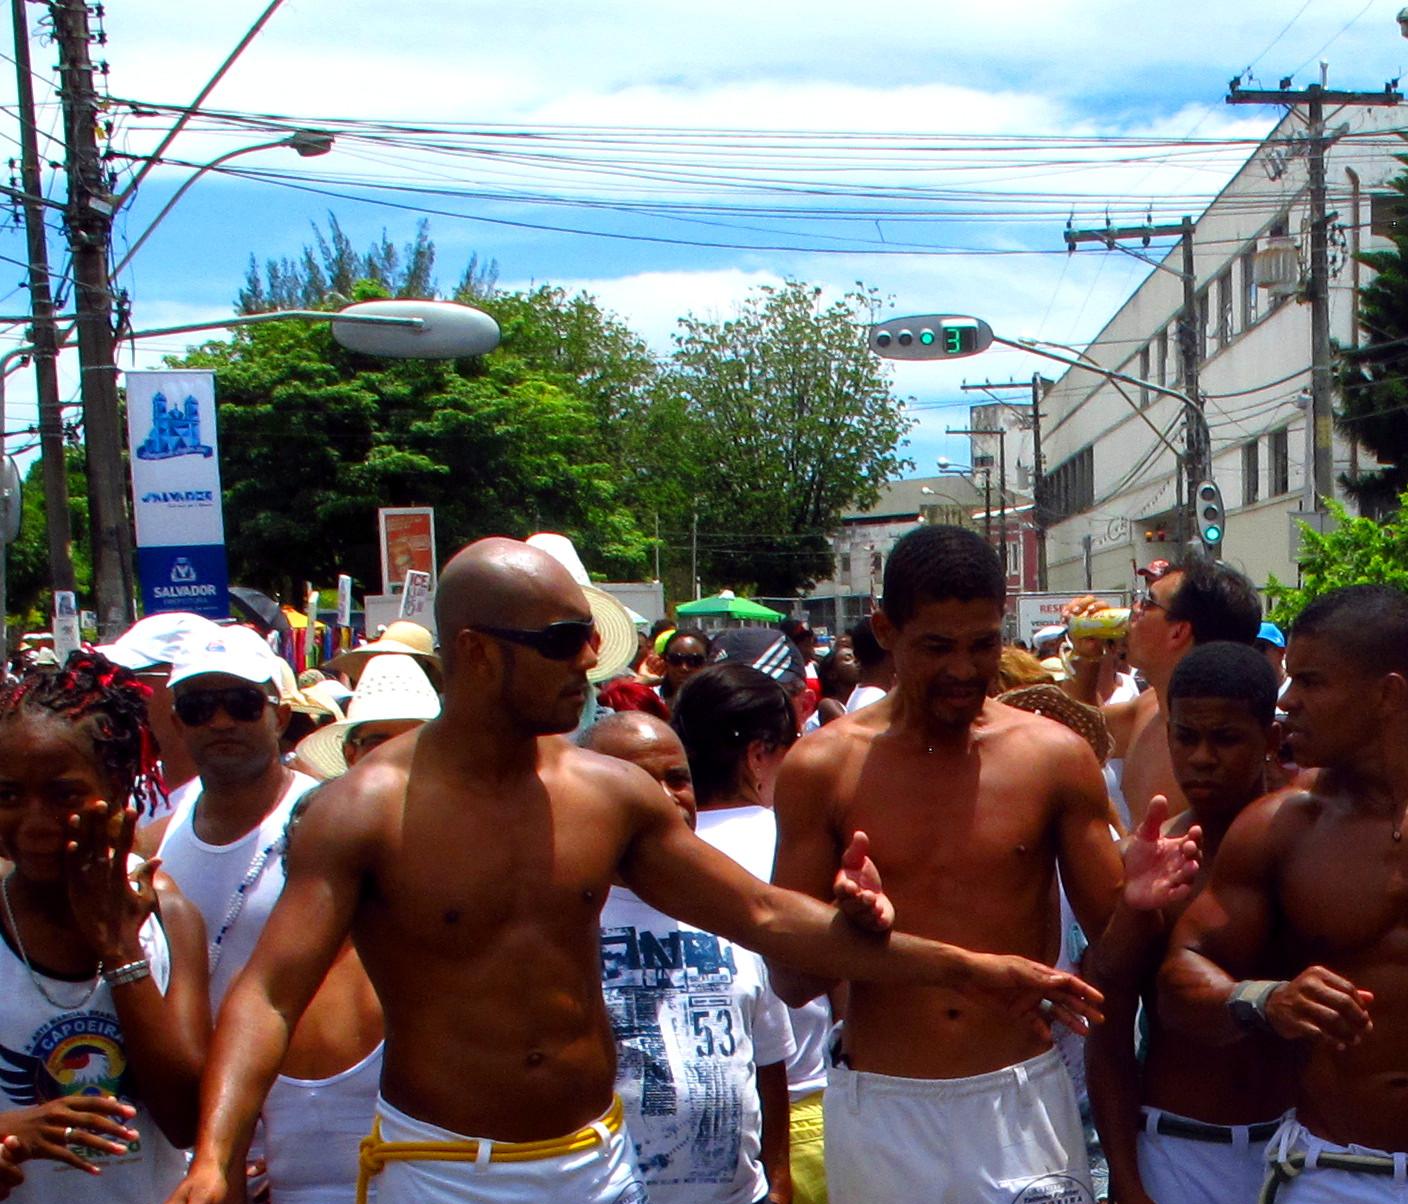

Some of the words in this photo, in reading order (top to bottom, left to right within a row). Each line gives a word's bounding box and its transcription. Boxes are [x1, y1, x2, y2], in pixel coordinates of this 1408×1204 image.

[947, 328, 960, 353] 3
[153, 583, 217, 598] SALVADOR
[693, 1009, 736, 1058] 53
